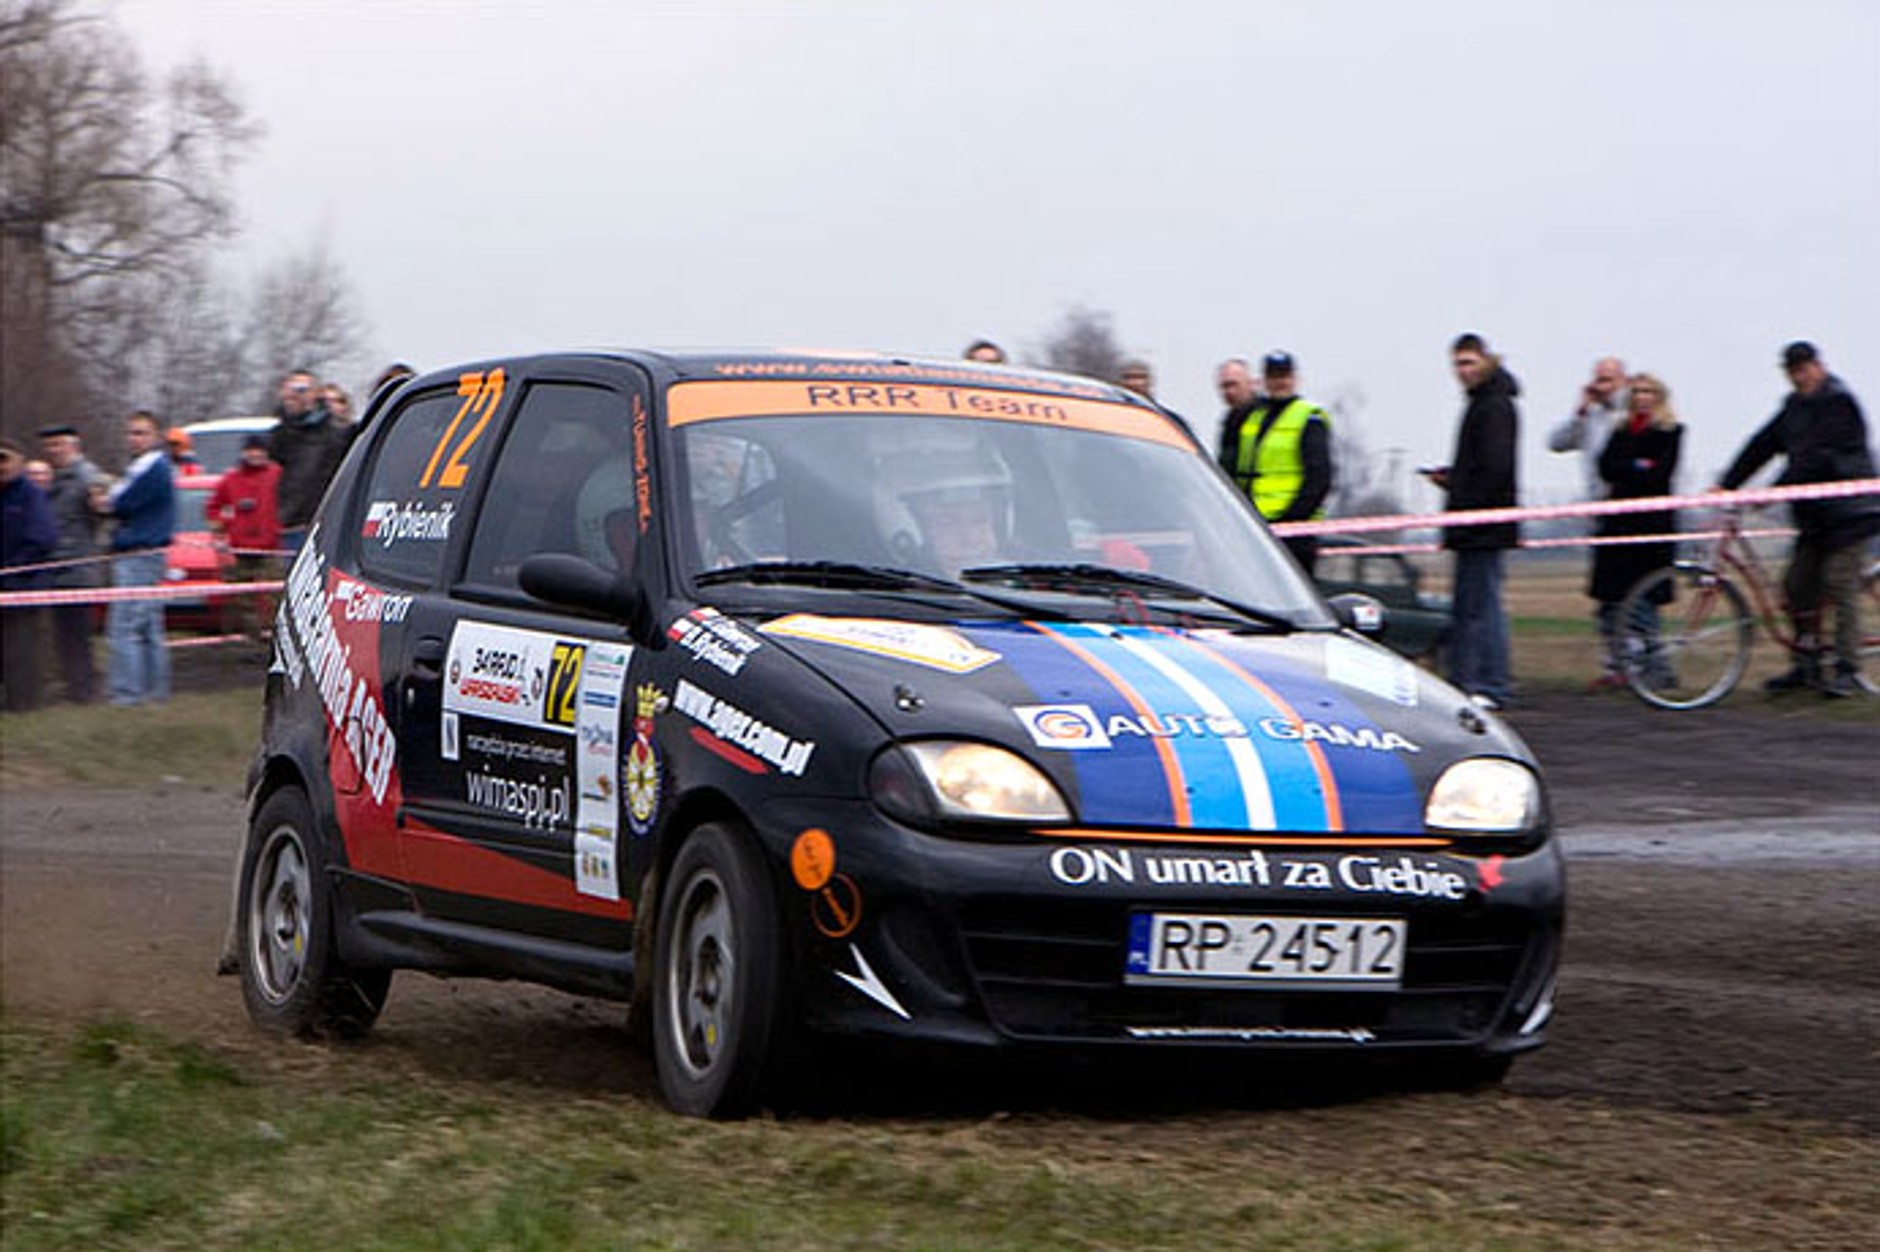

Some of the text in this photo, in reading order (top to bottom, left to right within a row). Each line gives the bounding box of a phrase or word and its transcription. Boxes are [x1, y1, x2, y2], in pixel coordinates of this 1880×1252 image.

[419, 366, 506, 489] 72
[806, 384, 1069, 422] RRR Team
[375, 499, 456, 547] Rybienik
[345, 582, 414, 623] Gawron
[546, 645, 584, 723] 72
[1105, 712, 1423, 755] AUTO GAMA
[1049, 844, 1466, 900] ON umarł za Ciebie
[1157, 919, 1231, 973] RP
[1248, 921, 1397, 976] 24512
